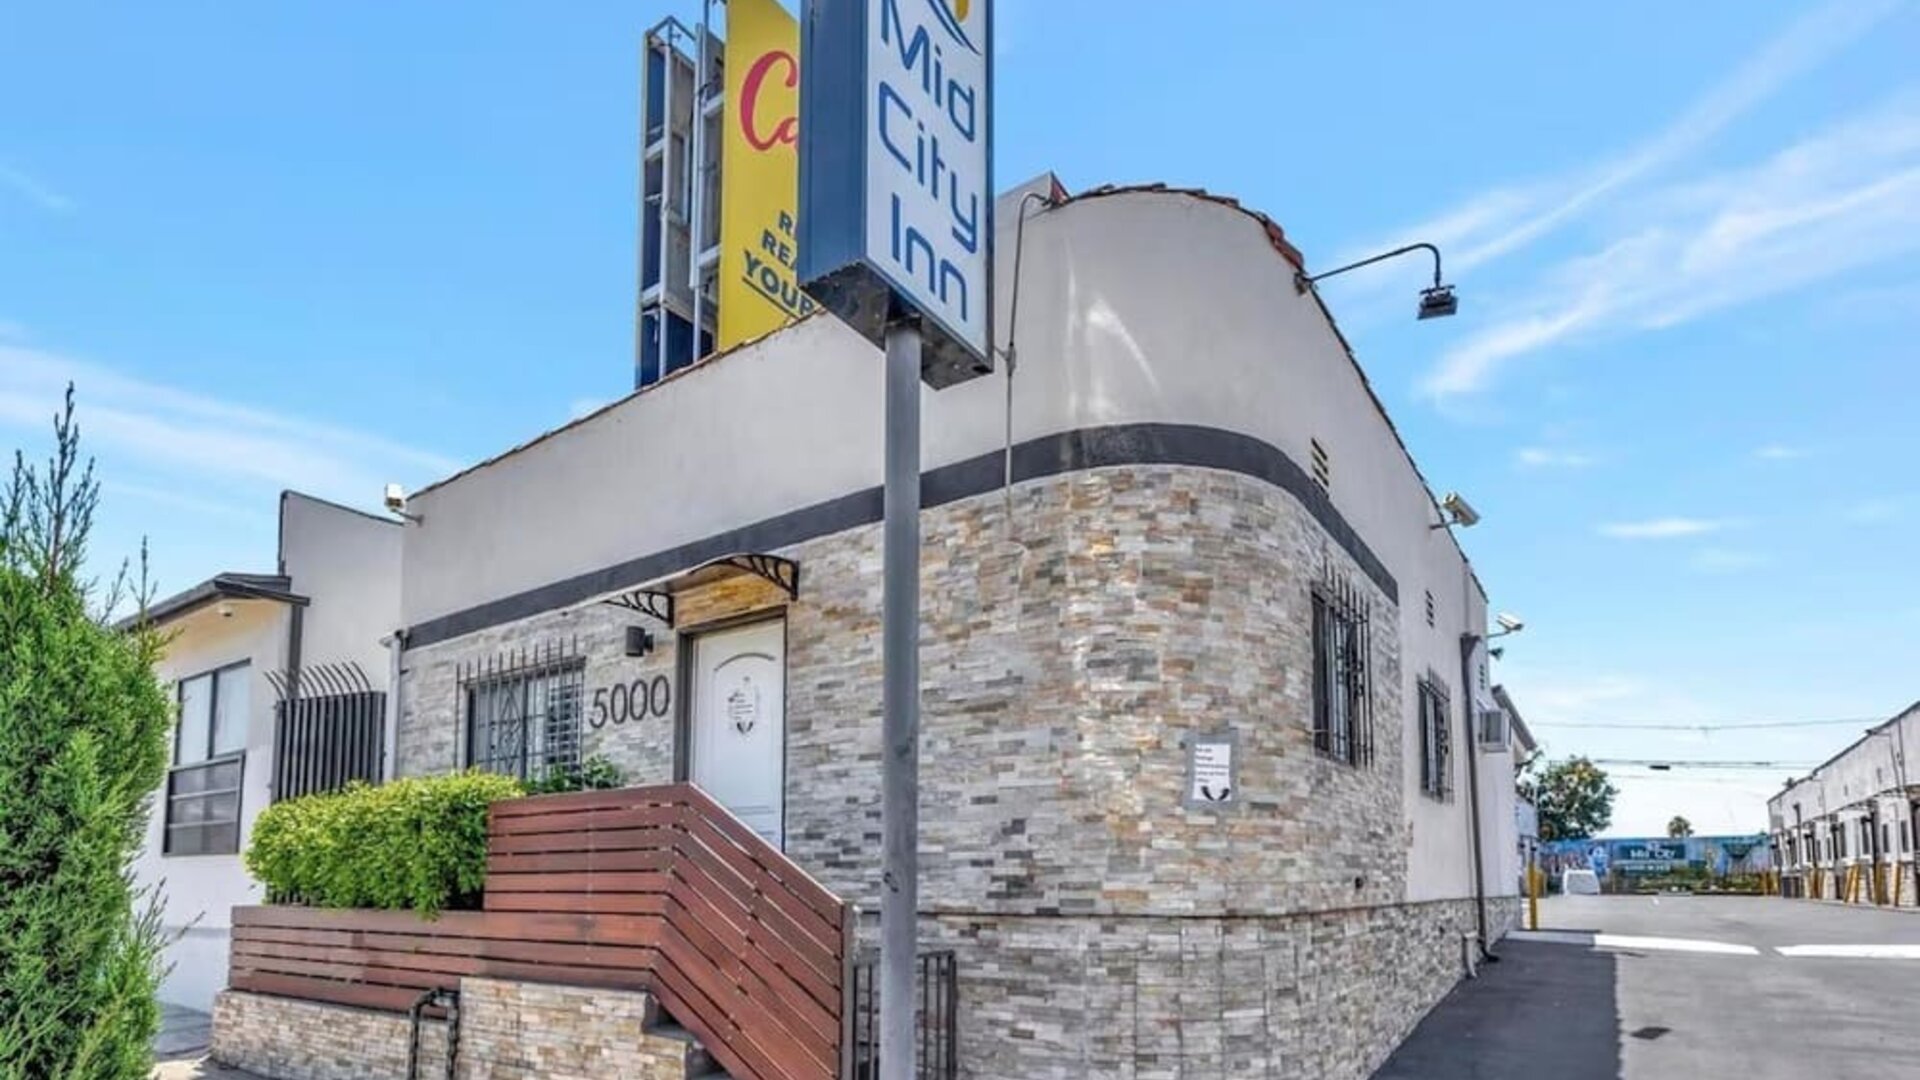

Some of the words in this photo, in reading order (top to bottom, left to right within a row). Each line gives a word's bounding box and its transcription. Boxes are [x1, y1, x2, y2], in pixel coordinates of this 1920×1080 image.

[880, 0, 975, 142] Mid
[879, 81, 977, 254] City
[762, 228, 797, 270] RE
[892, 192, 968, 323] Inn
[589, 674, 670, 729] 5000
